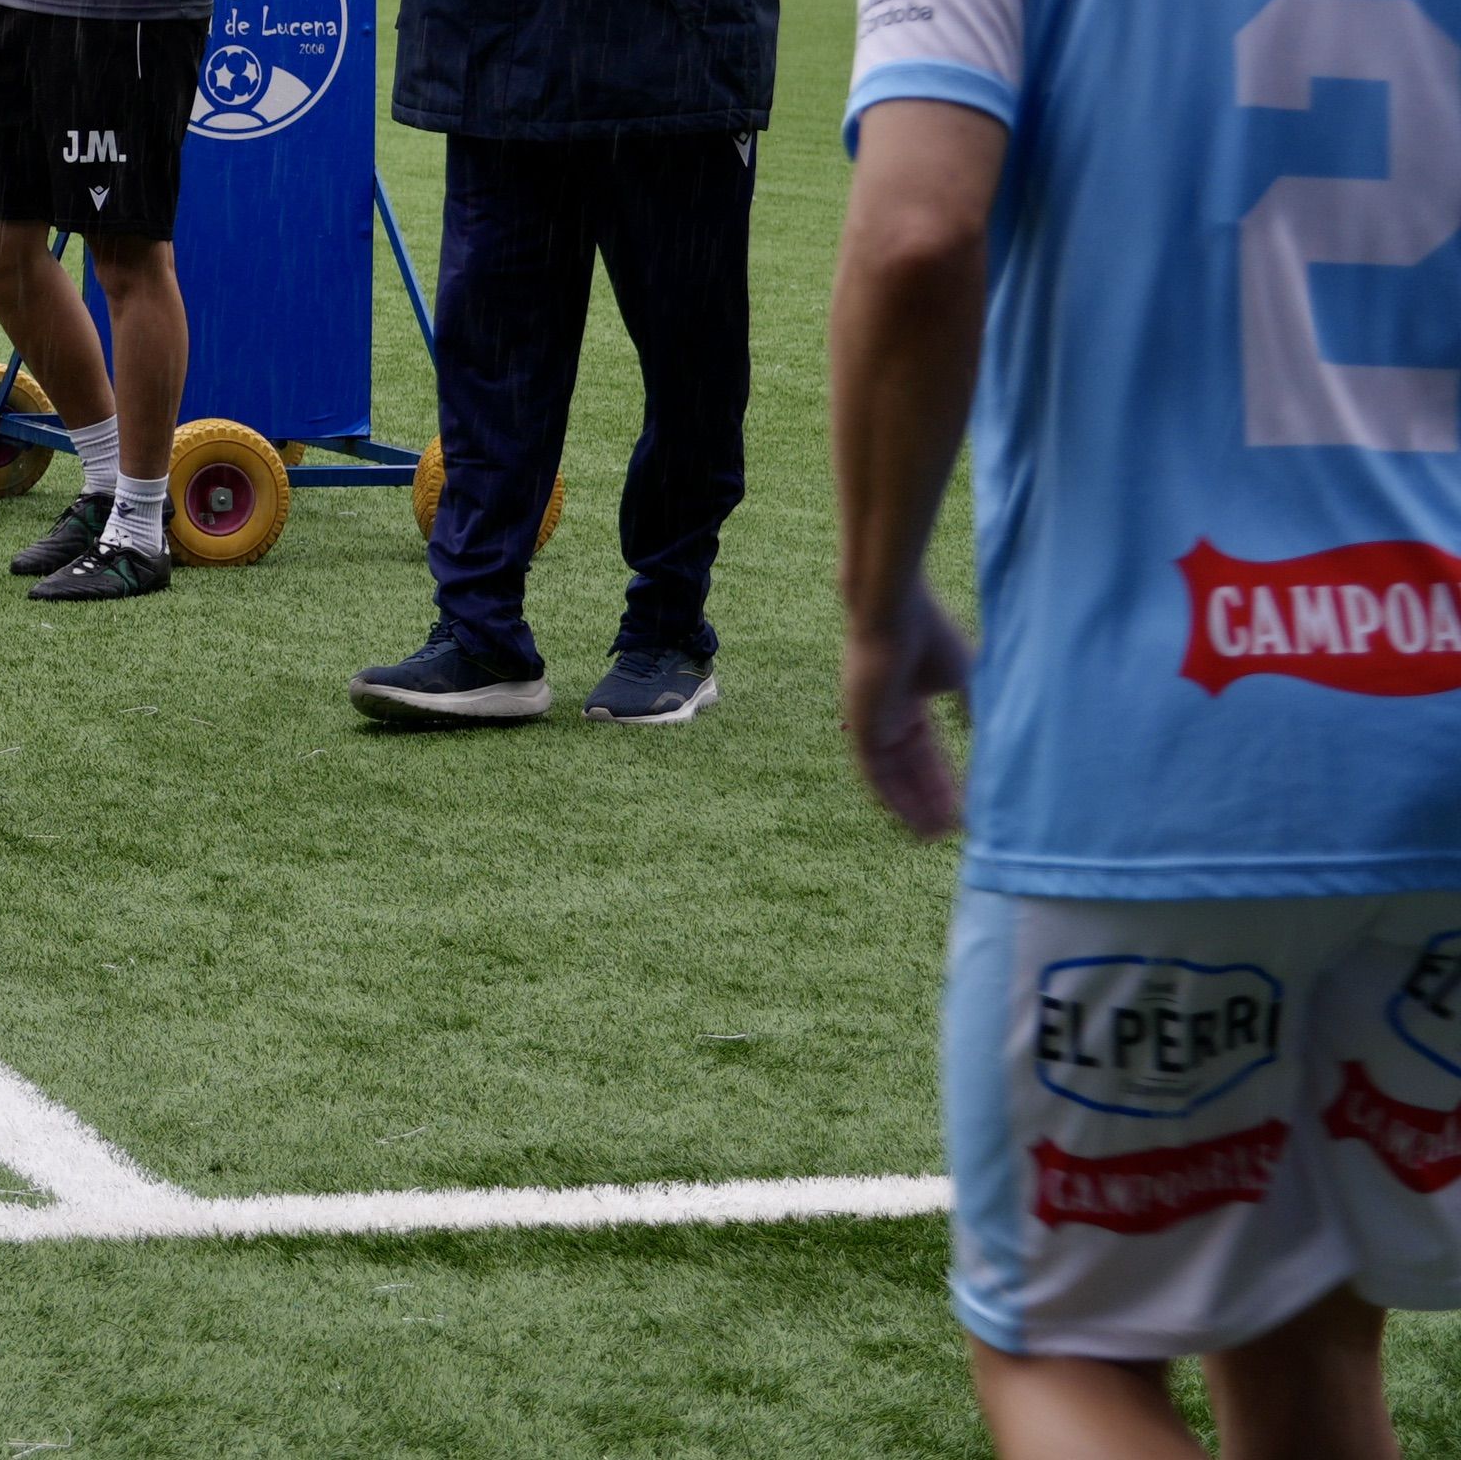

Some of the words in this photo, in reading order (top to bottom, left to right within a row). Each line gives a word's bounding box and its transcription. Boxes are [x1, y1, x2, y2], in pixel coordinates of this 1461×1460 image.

[224, 8, 251, 38] de
[262, 5, 338, 38] Lucena
[63, 130, 127, 163] J.M.
[1205, 581, 1461, 658] CAMPOA
